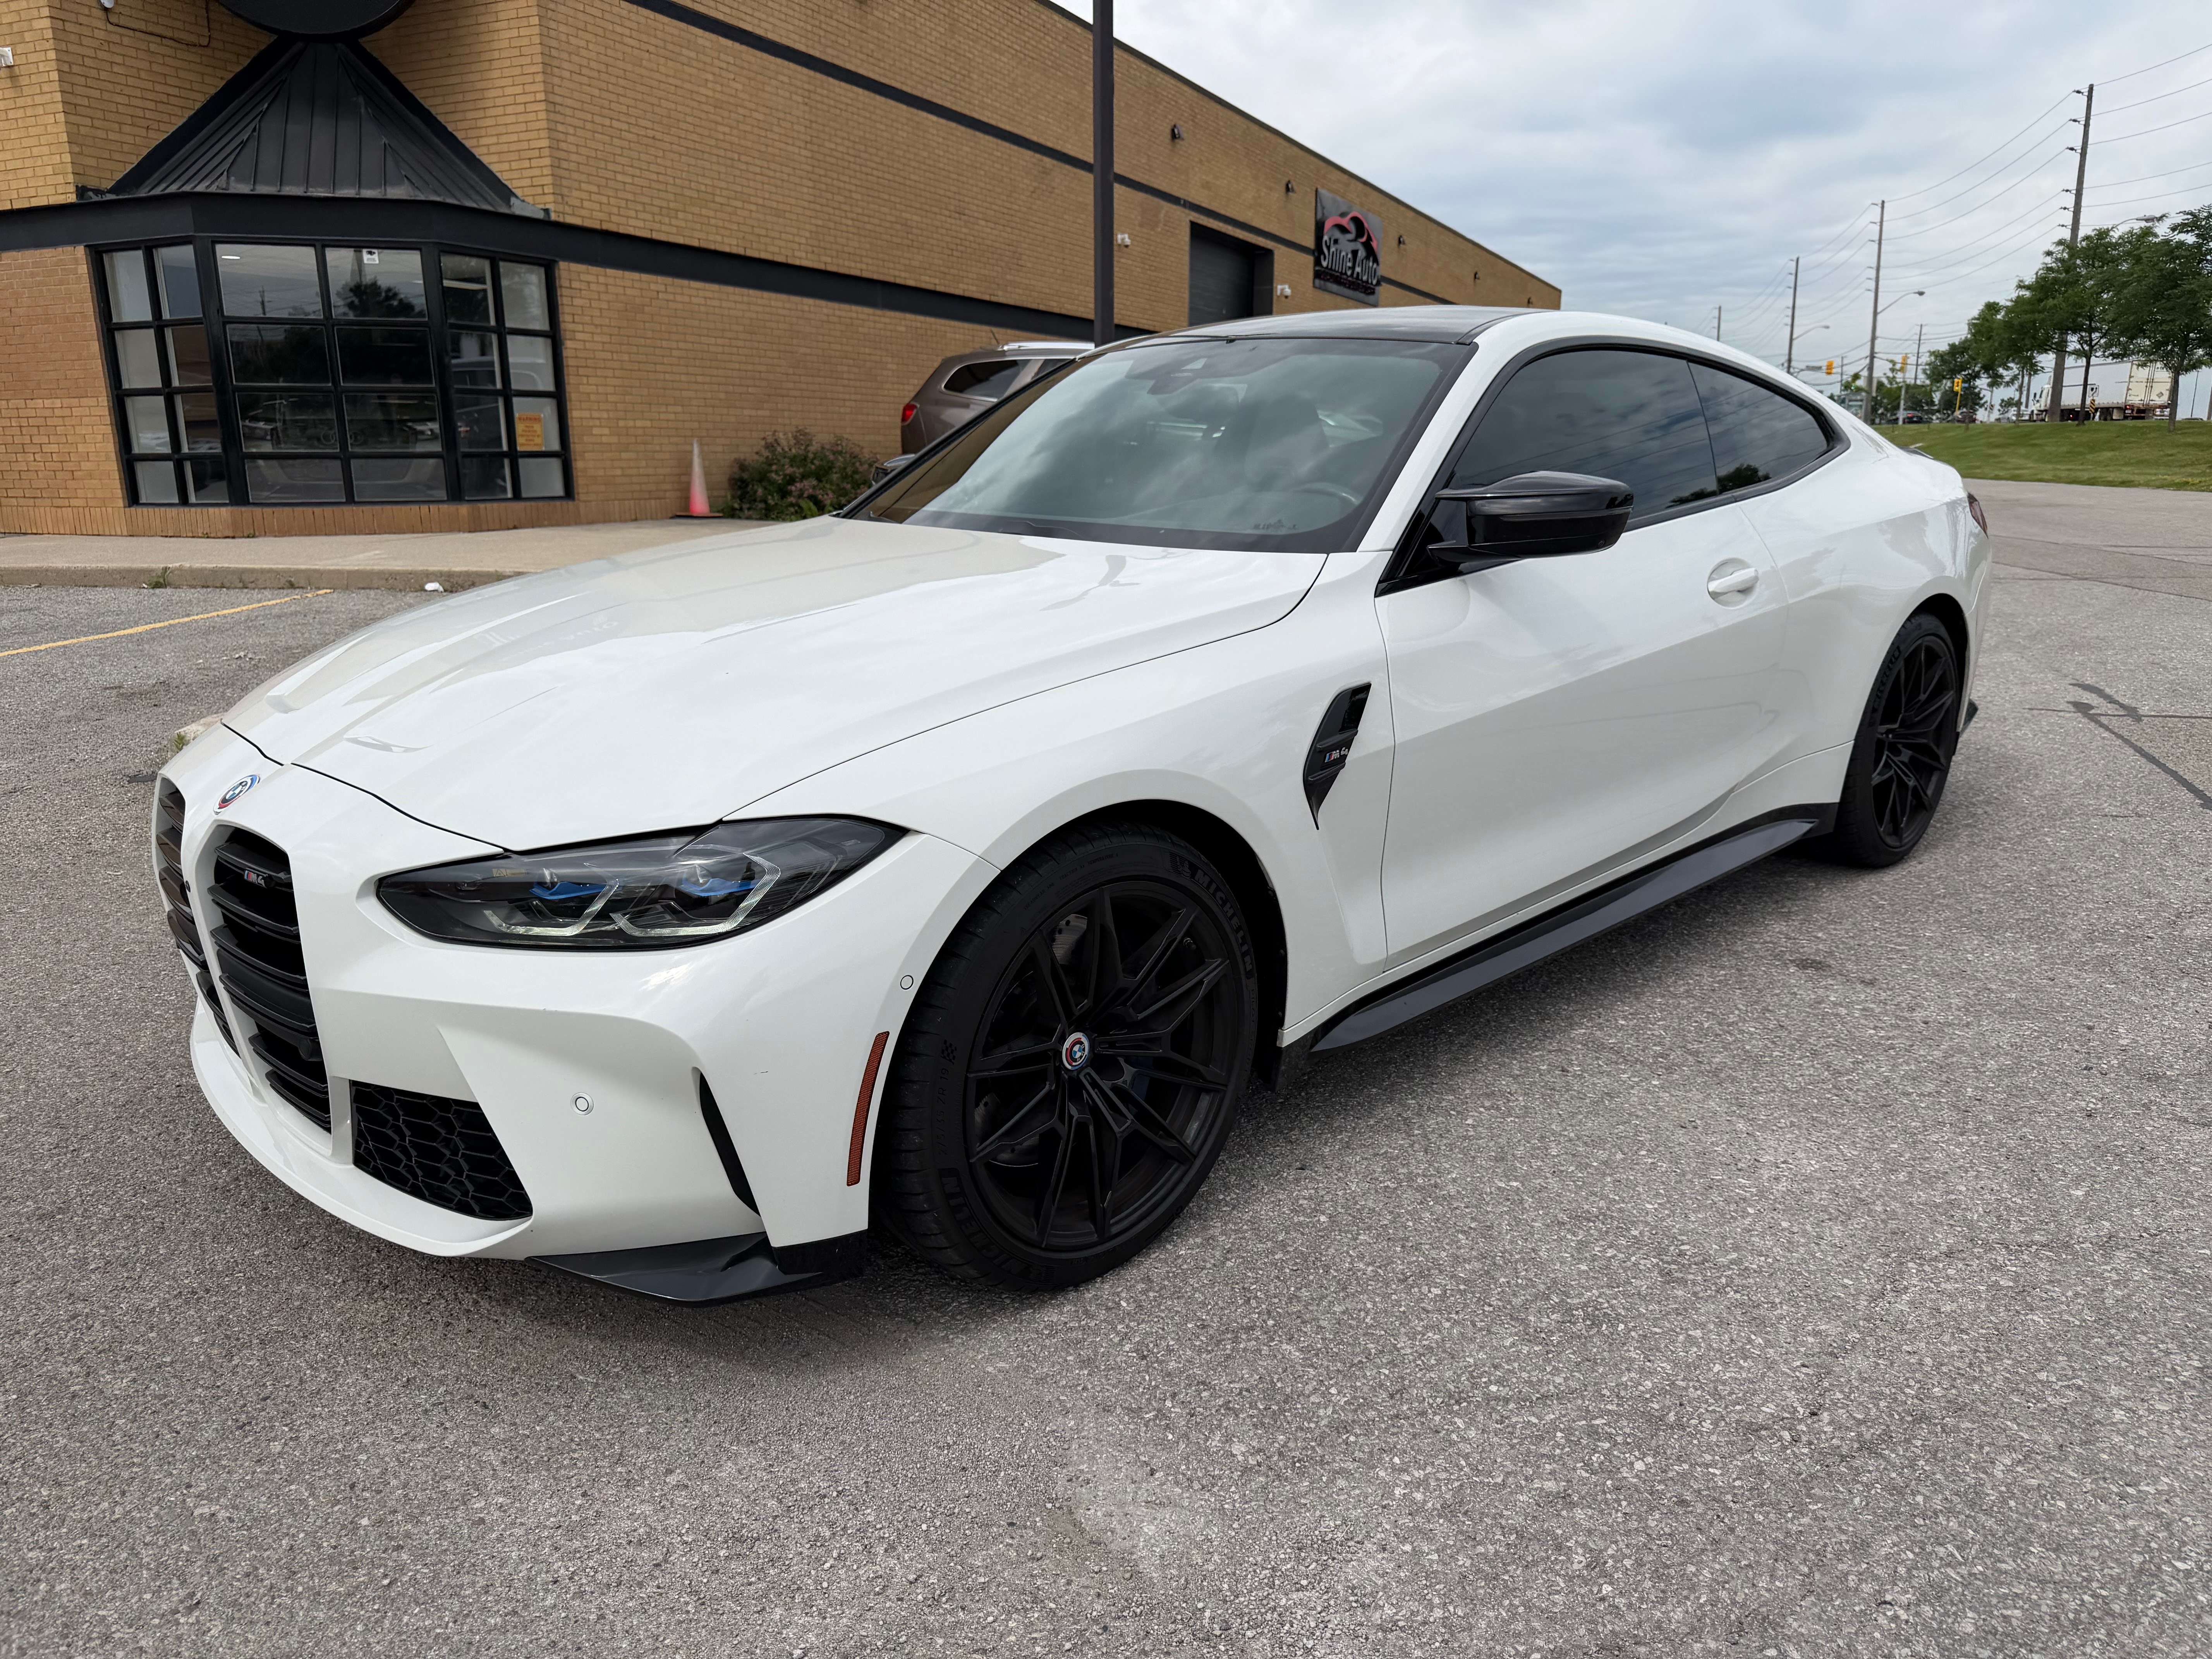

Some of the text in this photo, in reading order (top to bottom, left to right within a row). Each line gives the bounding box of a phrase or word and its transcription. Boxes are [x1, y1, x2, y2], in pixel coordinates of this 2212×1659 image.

[1321, 235, 1352, 276] Shine
[1354, 249, 1379, 285] Auto
[1195, 867, 1253, 974] MICHELIN
[937, 1087, 946, 1105] ZR
